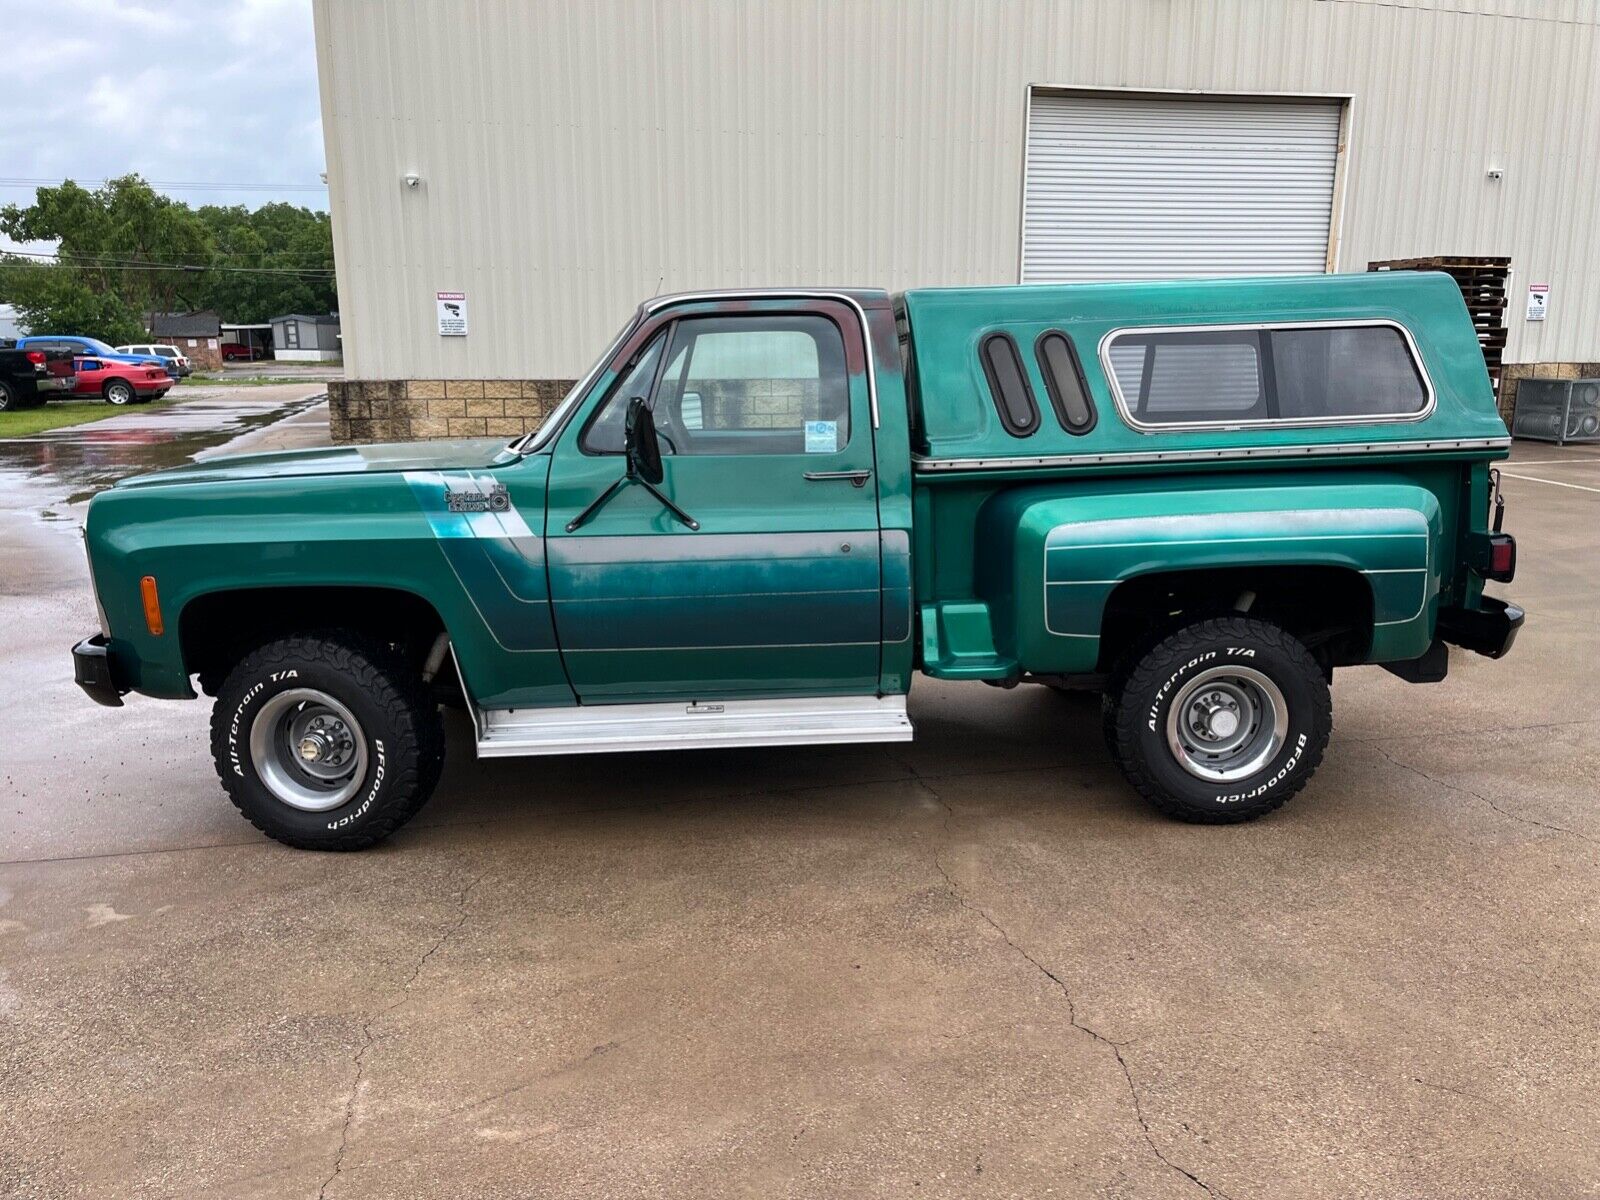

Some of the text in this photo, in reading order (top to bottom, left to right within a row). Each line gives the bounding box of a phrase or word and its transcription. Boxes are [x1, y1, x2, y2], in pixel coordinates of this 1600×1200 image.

[228, 669, 298, 777] All-Terrain T/A
[1148, 647, 1256, 732] All-Terrain T/A
[327, 739, 385, 830] BFGoodrich
[1216, 733, 1307, 804] BFGoodrich
